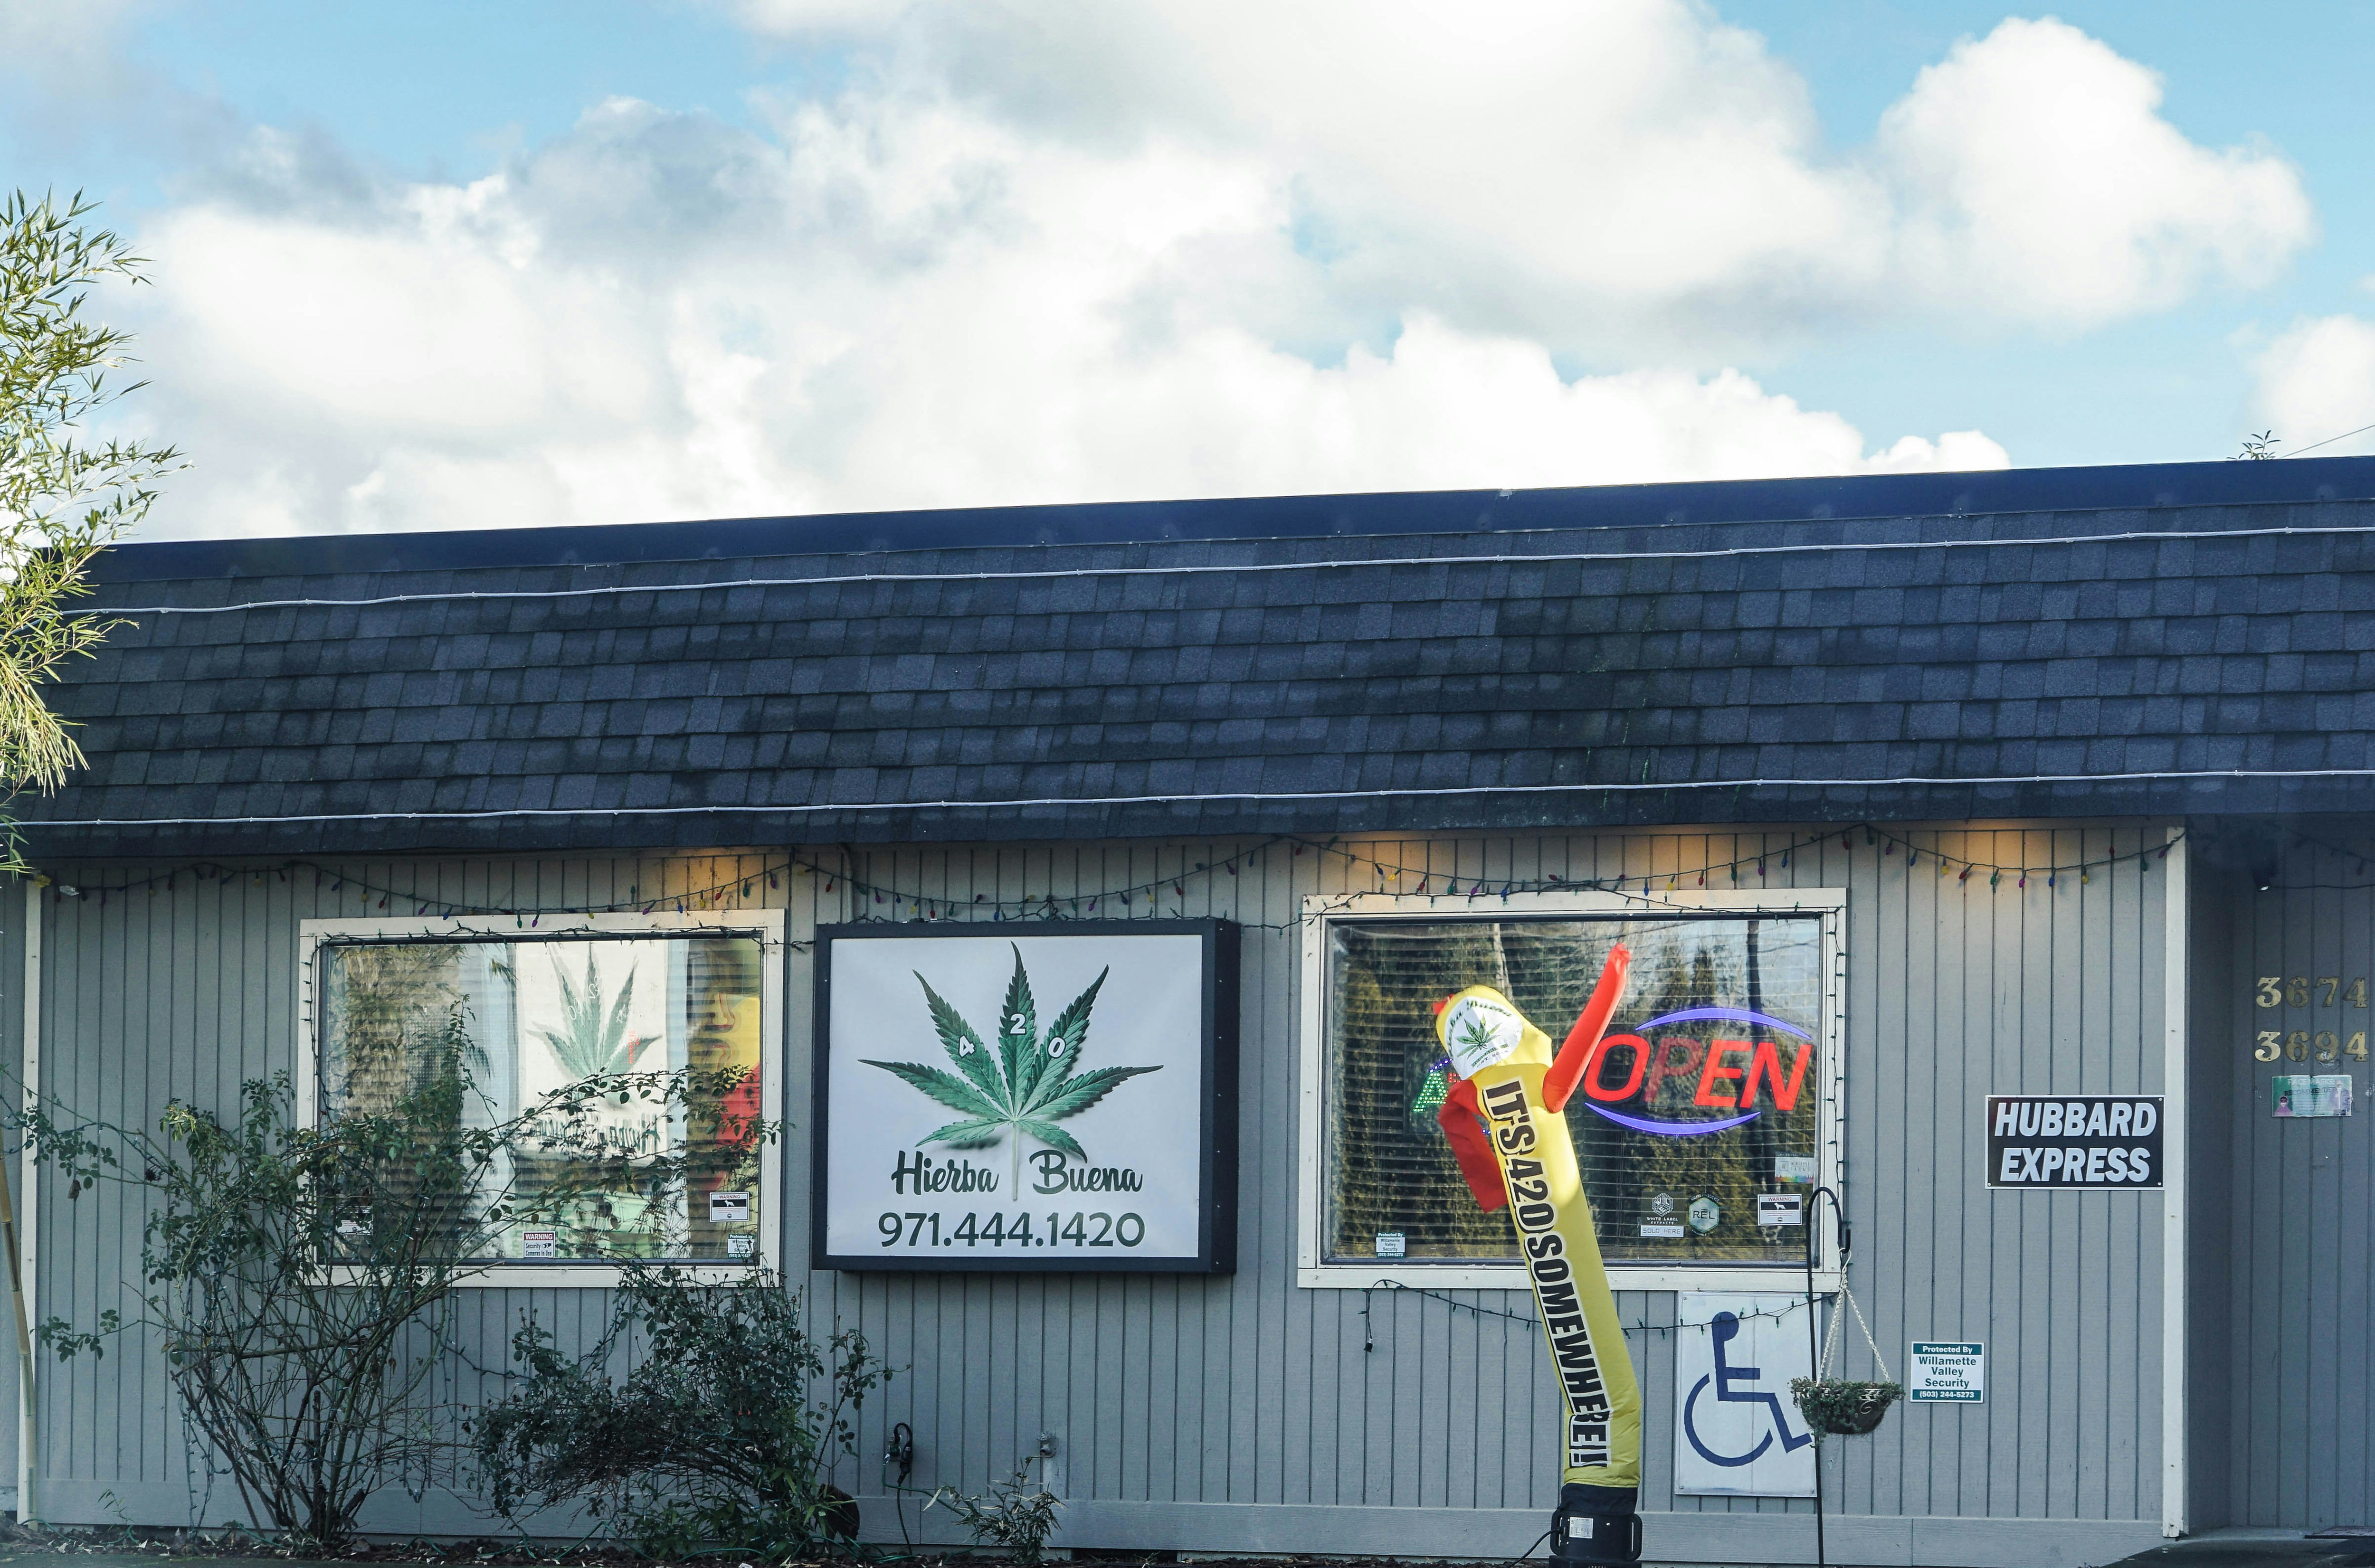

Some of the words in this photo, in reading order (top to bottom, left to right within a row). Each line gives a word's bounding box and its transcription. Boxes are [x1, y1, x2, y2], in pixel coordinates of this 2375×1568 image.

[2255, 976, 2368, 1009] 3674
[2254, 1030, 2368, 1062] 3694
[1583, 1033, 1814, 1112] OPEN
[1994, 1102, 2157, 1137] HUBBARD
[891, 1150, 999, 1196] Hierba
[1028, 1149, 1143, 1195] Buena
[1999, 1147, 2151, 1182] EXPRESS
[1508, 1158, 1555, 1229] 420
[878, 1211, 1146, 1247] 971.444.1420
[1918, 1356, 1977, 1366] Willamette
[1922, 1345, 1961, 1353] Protected
[1962, 1346, 1973, 1354] By
[1925, 1378, 1970, 1389] Security
[1931, 1366, 1964, 1378] Valley
[1919, 1390, 1938, 1398] (503)
